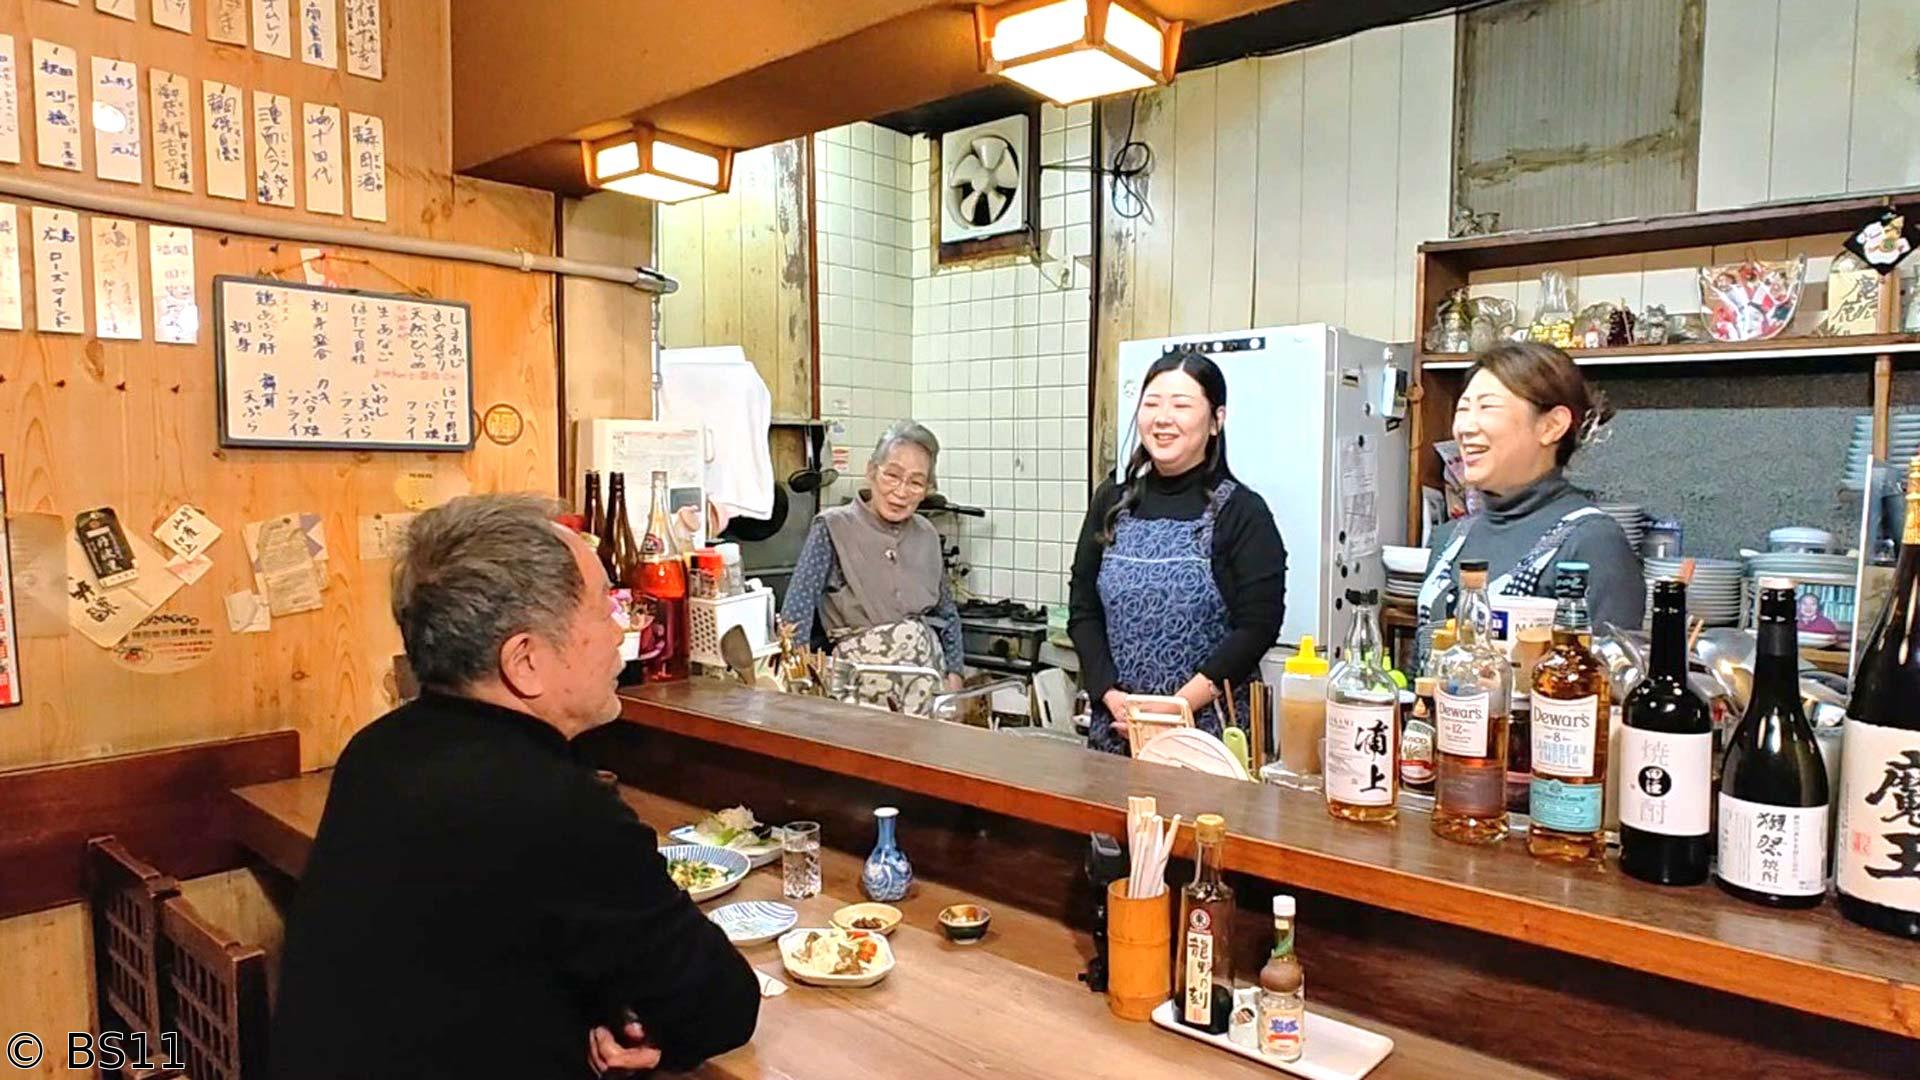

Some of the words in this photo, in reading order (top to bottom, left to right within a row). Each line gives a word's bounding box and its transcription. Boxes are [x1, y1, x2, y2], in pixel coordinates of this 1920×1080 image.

[311, 128, 333, 184] 十四代
[376, 305, 393, 362] 生あなご
[409, 306, 428, 369] 天然ひらめ
[449, 312, 465, 369] しまあじ
[371, 383, 388, 417] いわし
[1451, 725, 1464, 736] 12
[1534, 704, 1590, 729] Dewar's
[1553, 733, 1561, 743] 8
[1354, 718, 1389, 794] 浦上
